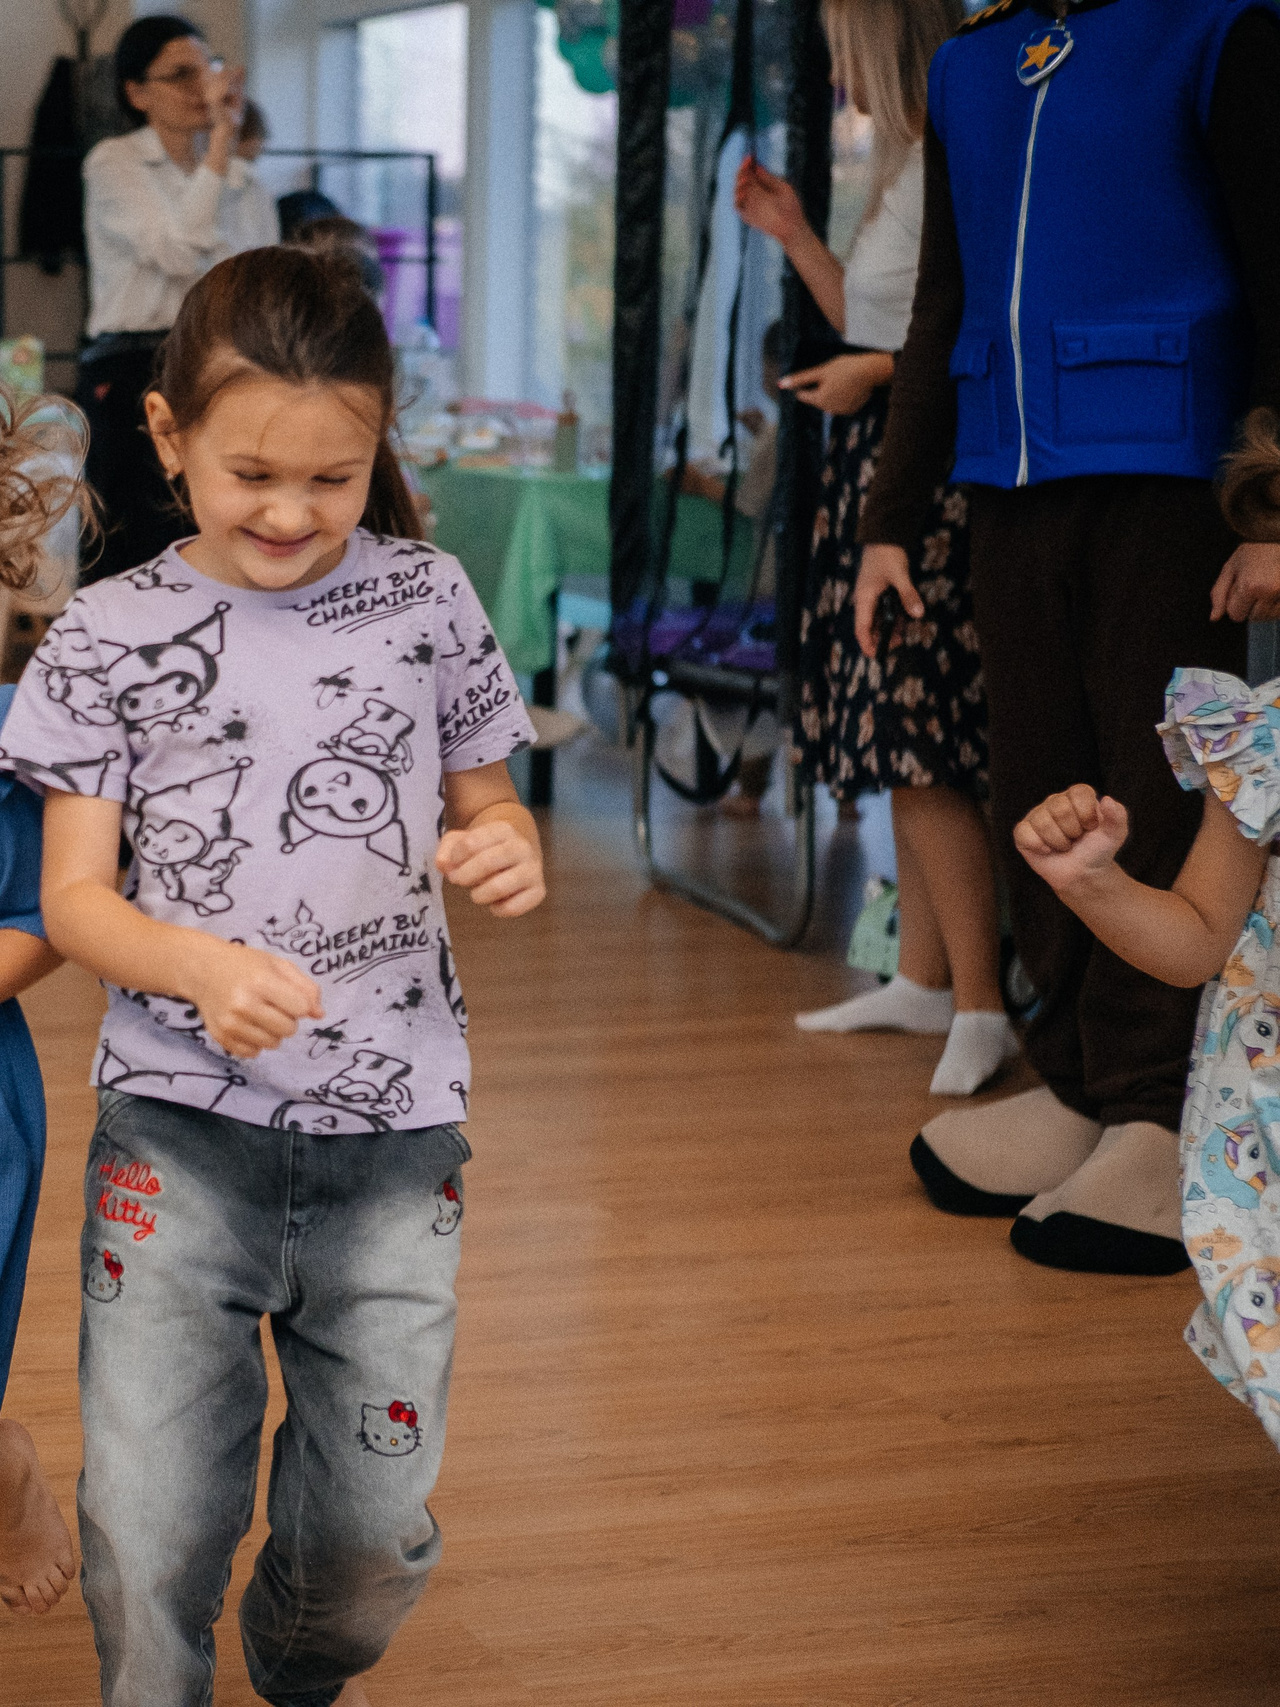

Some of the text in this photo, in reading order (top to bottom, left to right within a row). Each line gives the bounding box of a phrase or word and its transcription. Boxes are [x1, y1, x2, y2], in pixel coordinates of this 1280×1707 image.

[386, 560, 434, 588] BUT
[306, 580, 434, 627] CHARMING
[465, 662, 503, 705] BUT
[441, 687, 510, 744] RMING
[299, 916, 385, 957] CHEEKY
[310, 929, 429, 975] CHARMING
[98, 1154, 162, 1196] Hello
[95, 1186, 157, 1241] Kitty
